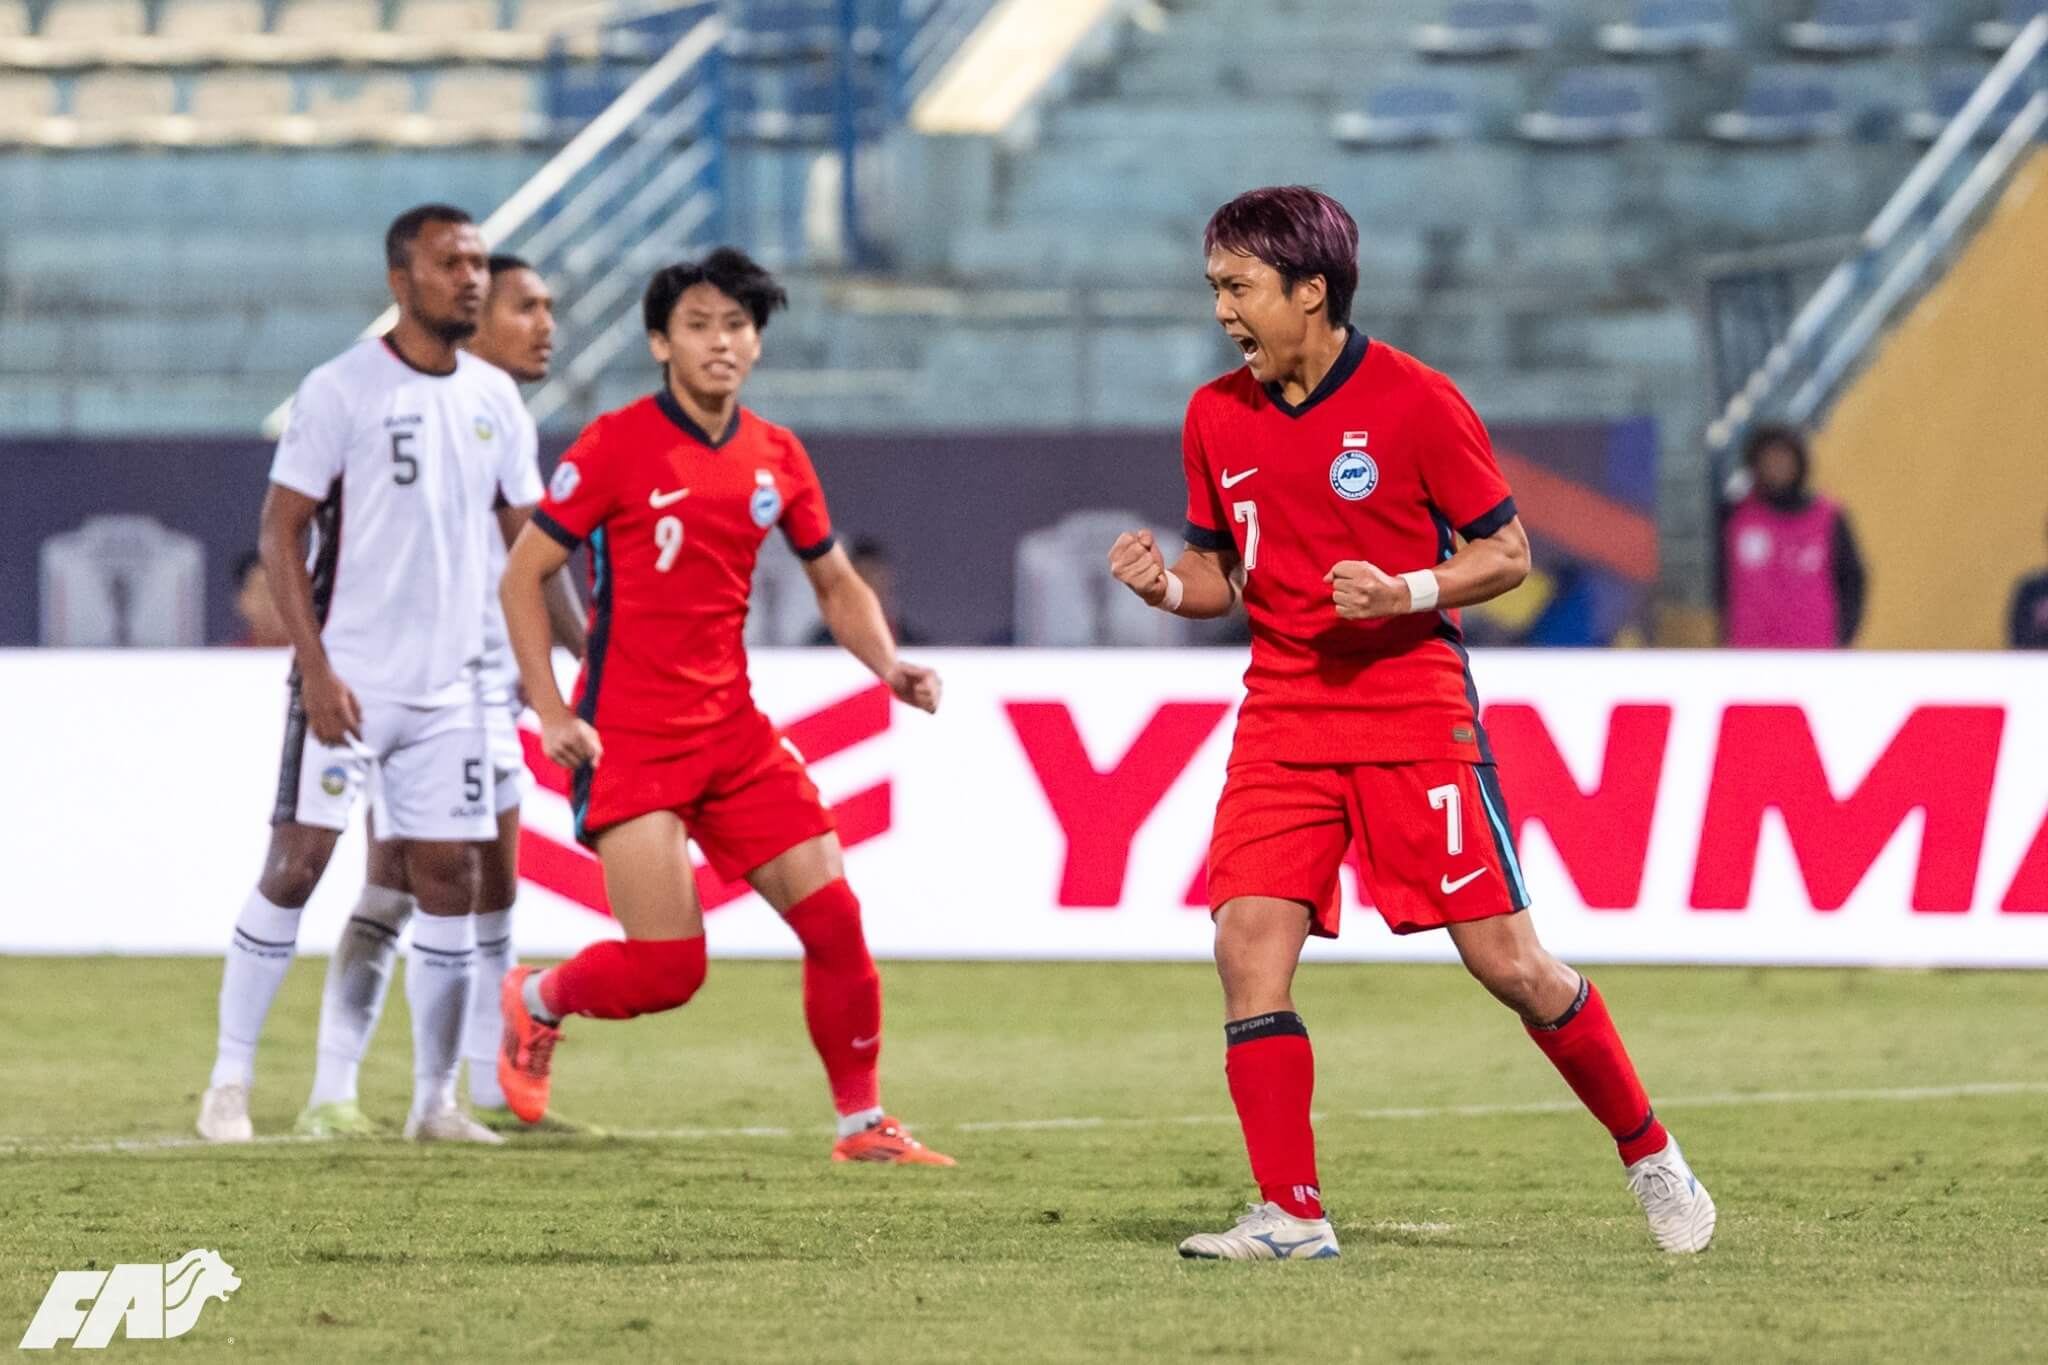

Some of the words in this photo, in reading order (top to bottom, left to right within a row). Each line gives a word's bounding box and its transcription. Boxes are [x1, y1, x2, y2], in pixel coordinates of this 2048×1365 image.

[390, 431, 418, 486] 5
[655, 515, 684, 573] 9
[1233, 500, 1260, 570] 7
[464, 758, 482, 802] 5
[1003, 702, 2048, 912] YNM
[1427, 783, 1463, 856] 7
